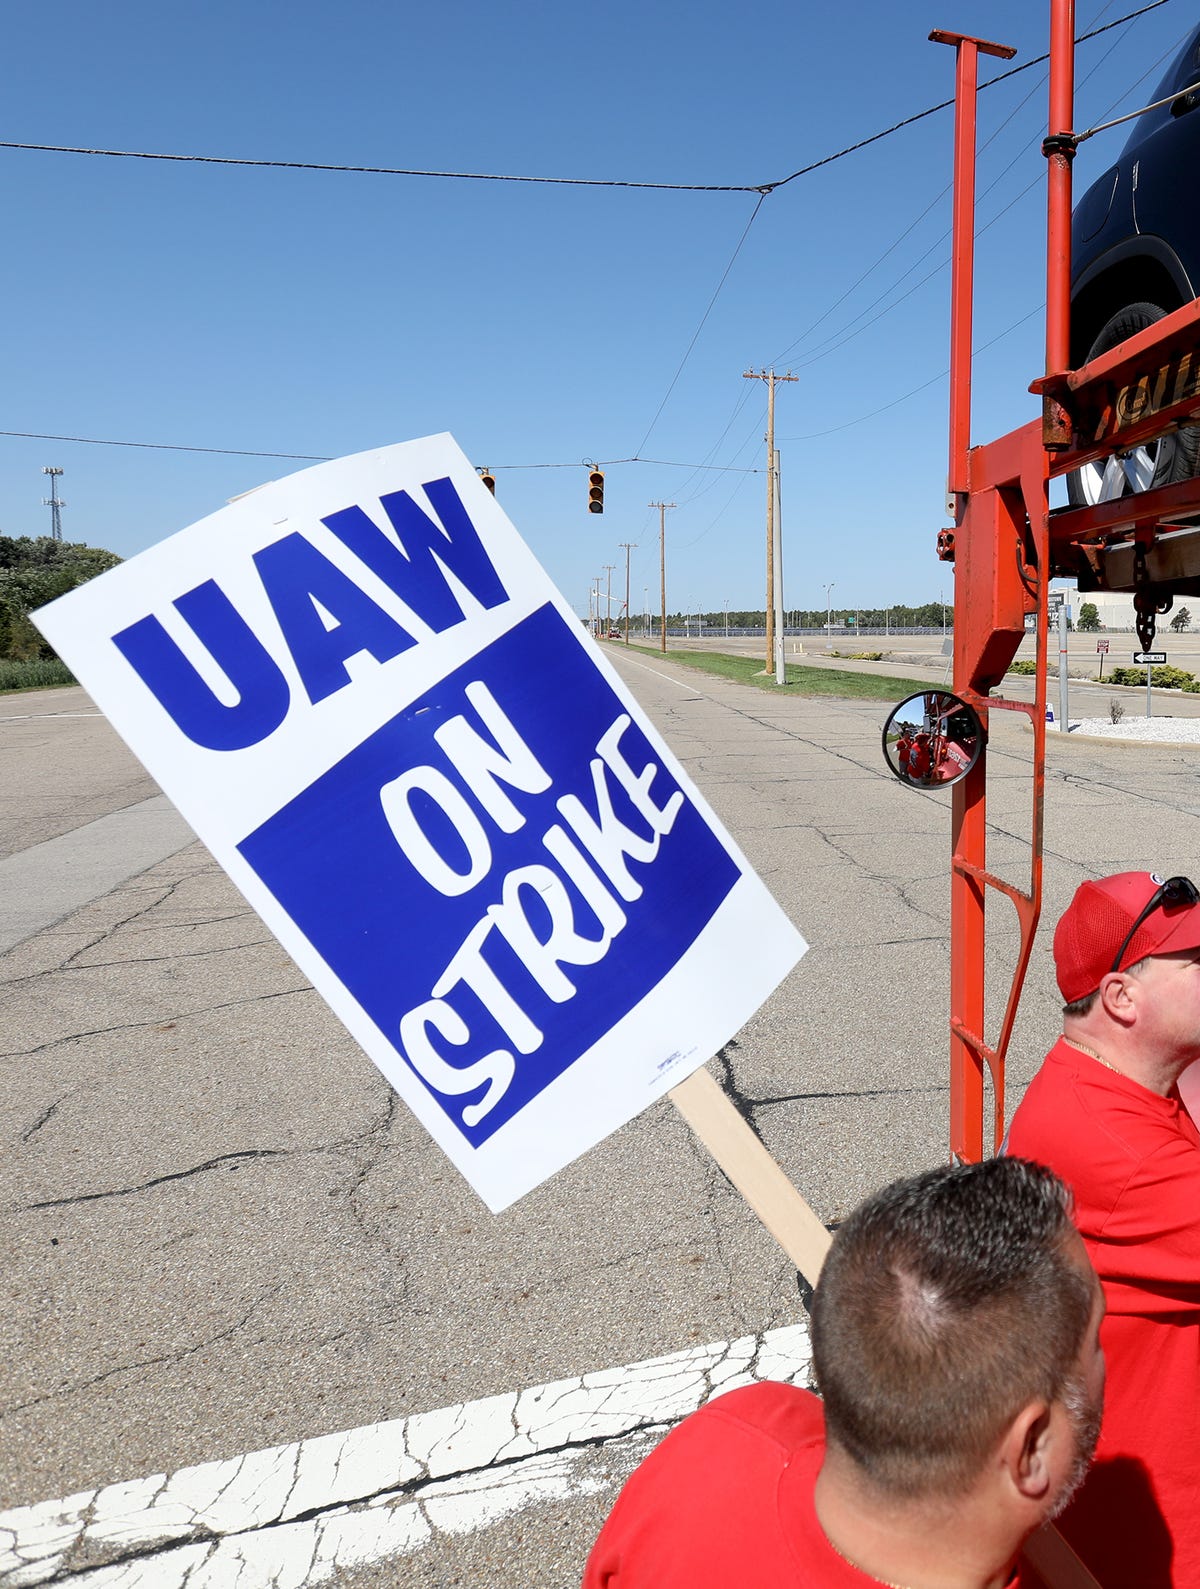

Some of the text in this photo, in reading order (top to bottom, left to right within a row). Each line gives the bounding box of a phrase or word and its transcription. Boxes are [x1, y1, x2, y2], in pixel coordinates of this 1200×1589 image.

[111, 476, 511, 751] UAW
[380, 680, 552, 897] ON
[400, 713, 685, 1128] STRIKE
